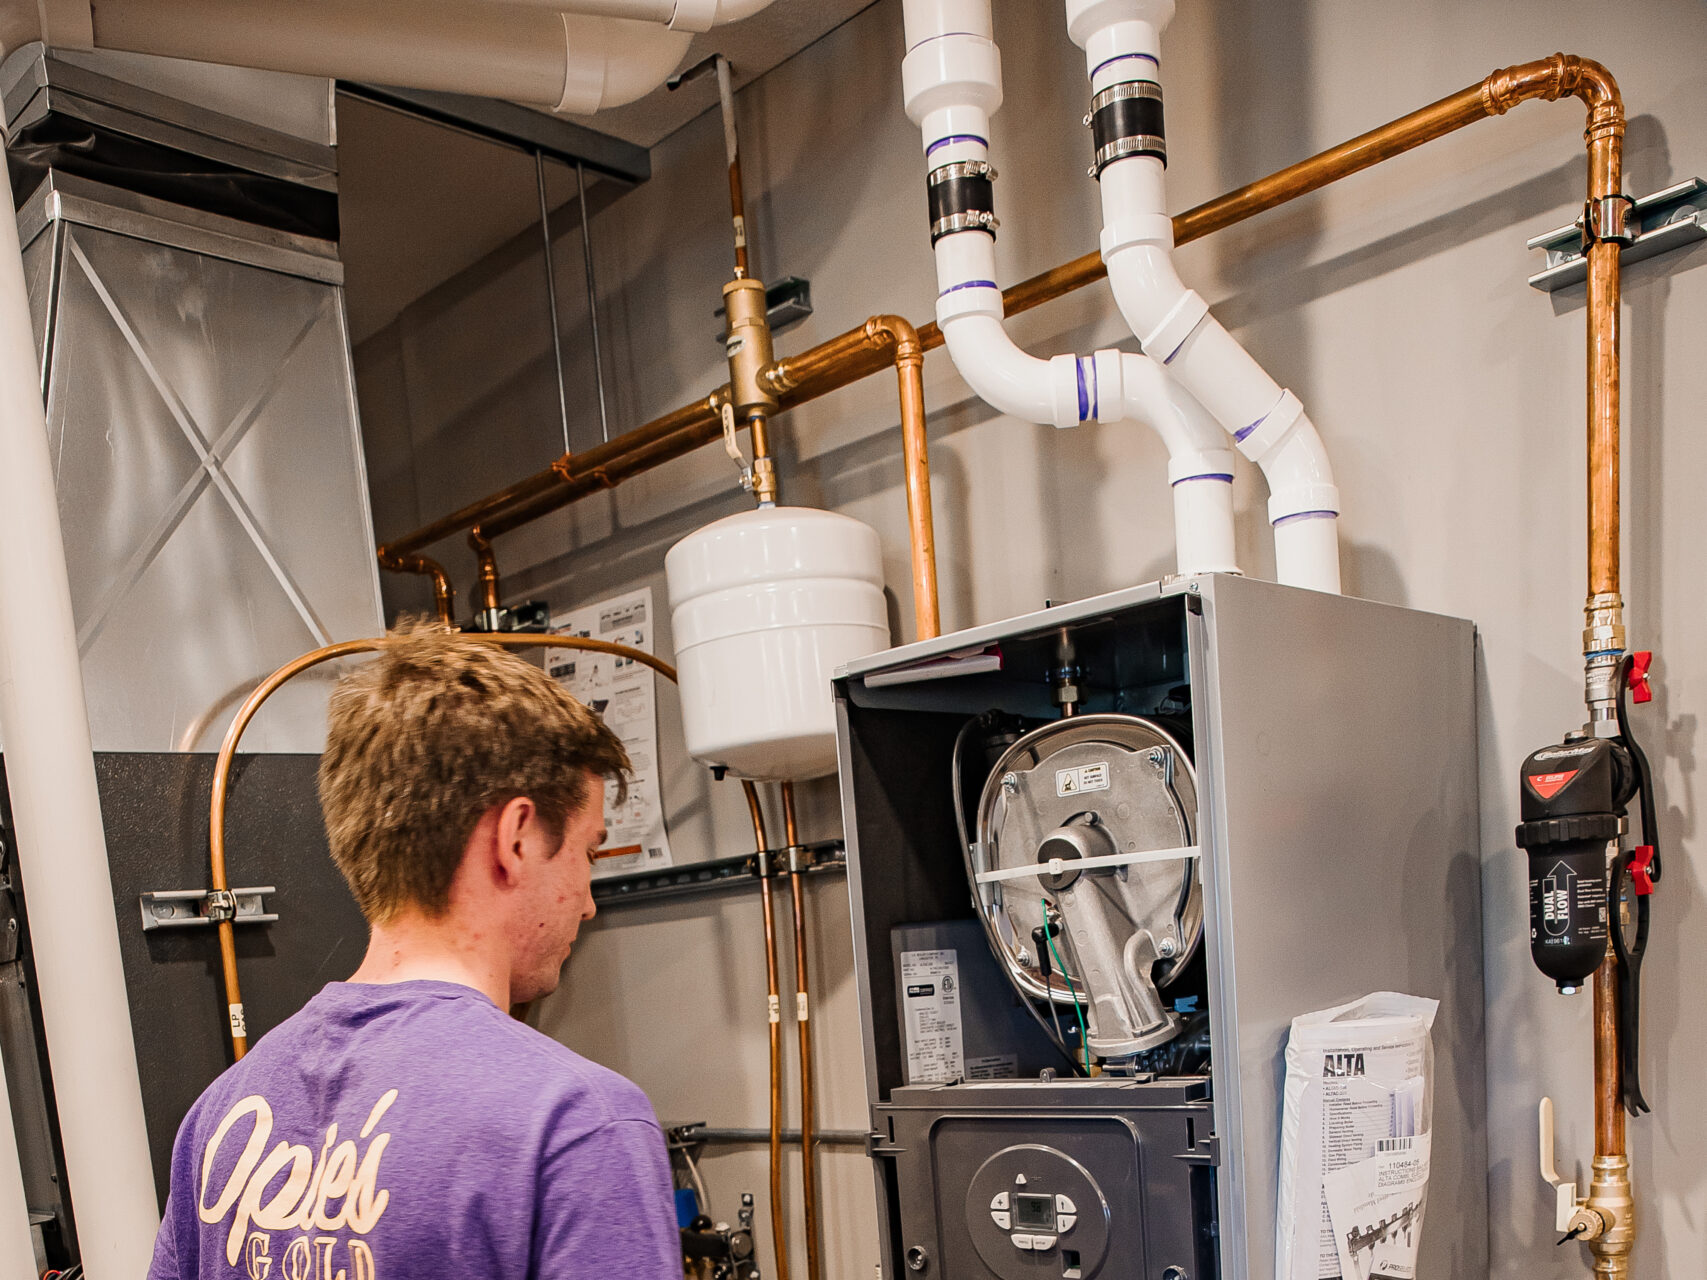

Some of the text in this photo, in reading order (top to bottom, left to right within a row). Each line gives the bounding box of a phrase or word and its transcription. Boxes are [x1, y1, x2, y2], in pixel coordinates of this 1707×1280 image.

[1544, 891, 1554, 920] DUAL
[1557, 890, 1568, 919] FLOW
[232, 1014, 240, 1027] LP
[1323, 1054, 1365, 1077] ALTA
